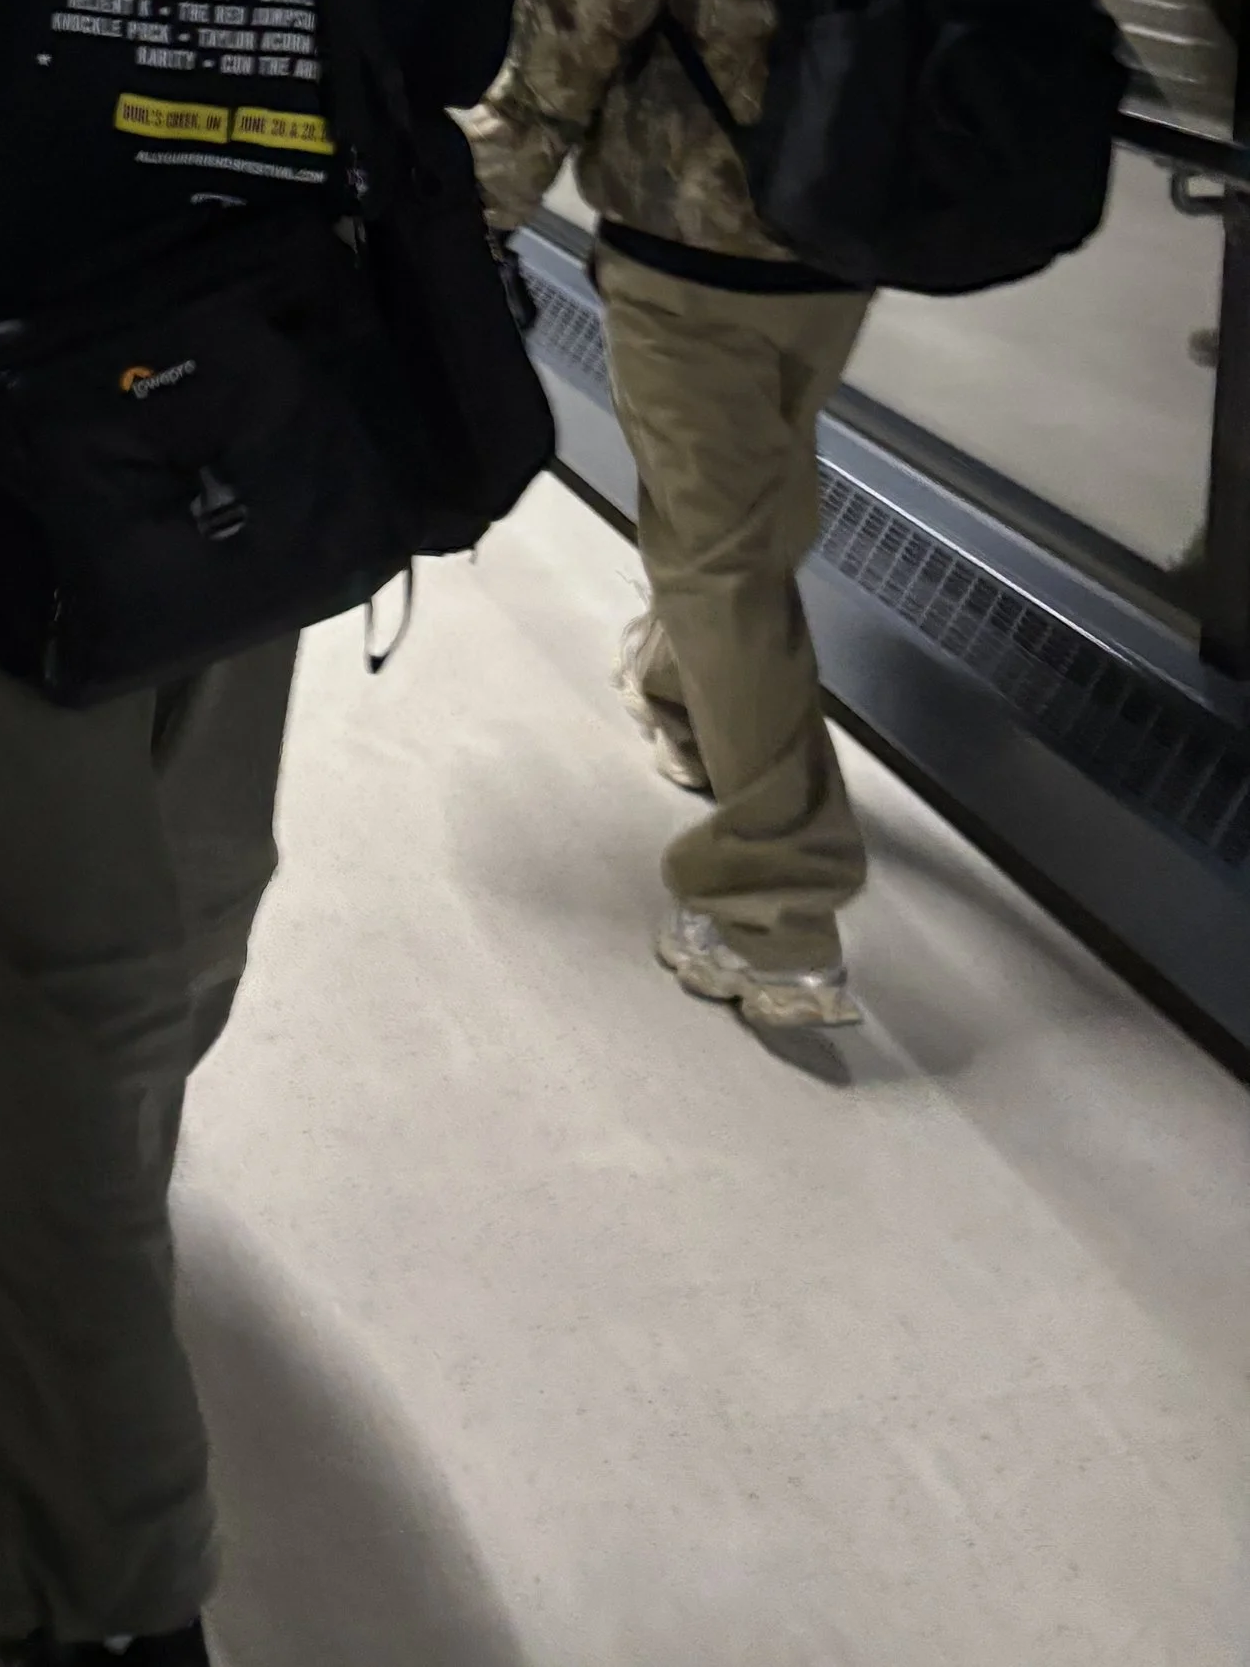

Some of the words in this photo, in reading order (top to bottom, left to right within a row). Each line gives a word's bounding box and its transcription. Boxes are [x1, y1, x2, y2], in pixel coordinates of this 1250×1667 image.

[177, 2, 210, 23] THE
[51, 12, 124, 38] KNUCKLE
[240, 114, 266, 134] JUNE
